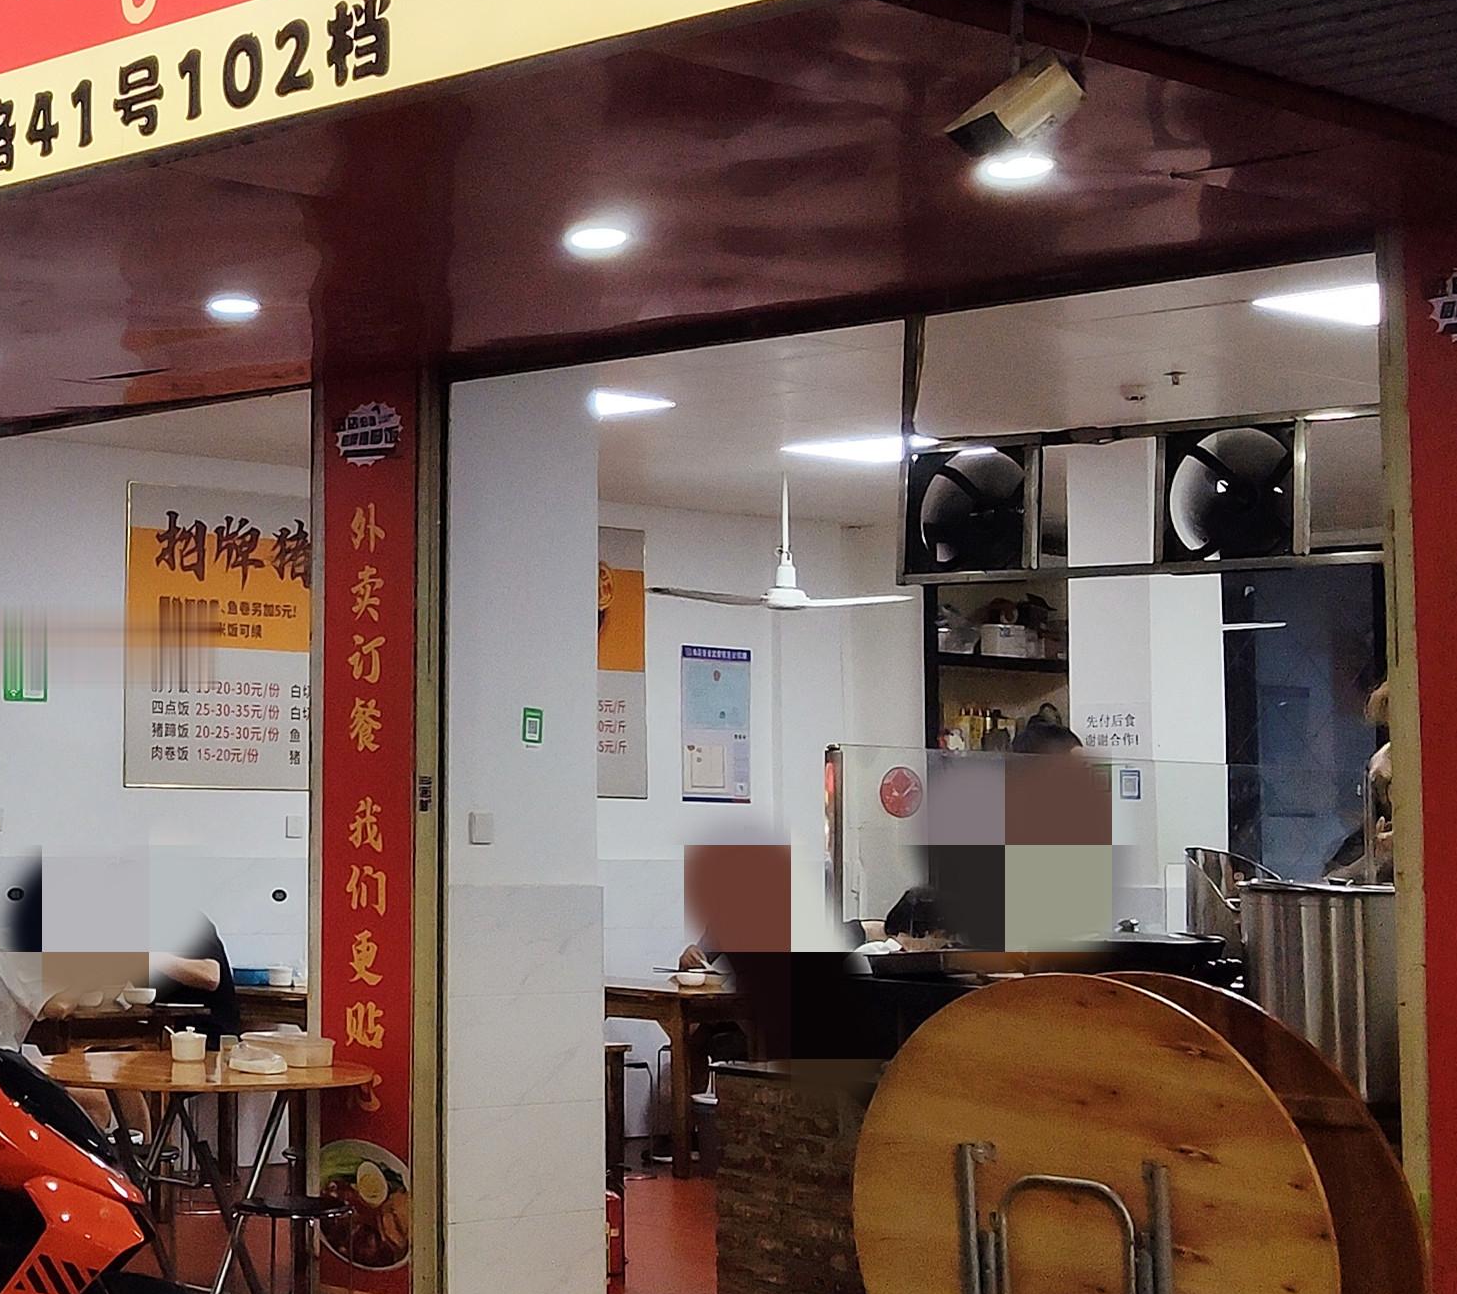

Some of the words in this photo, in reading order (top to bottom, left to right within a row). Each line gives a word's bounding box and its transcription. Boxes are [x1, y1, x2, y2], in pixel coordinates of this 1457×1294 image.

[155, 510, 311, 592] 招牌猪
[347, 502, 387, 753] 外卖订餐
[152, 700, 189, 717] 四点饭
[1086, 713, 1136, 728] 先付后食
[151, 722, 189, 739] 猪蹄饭
